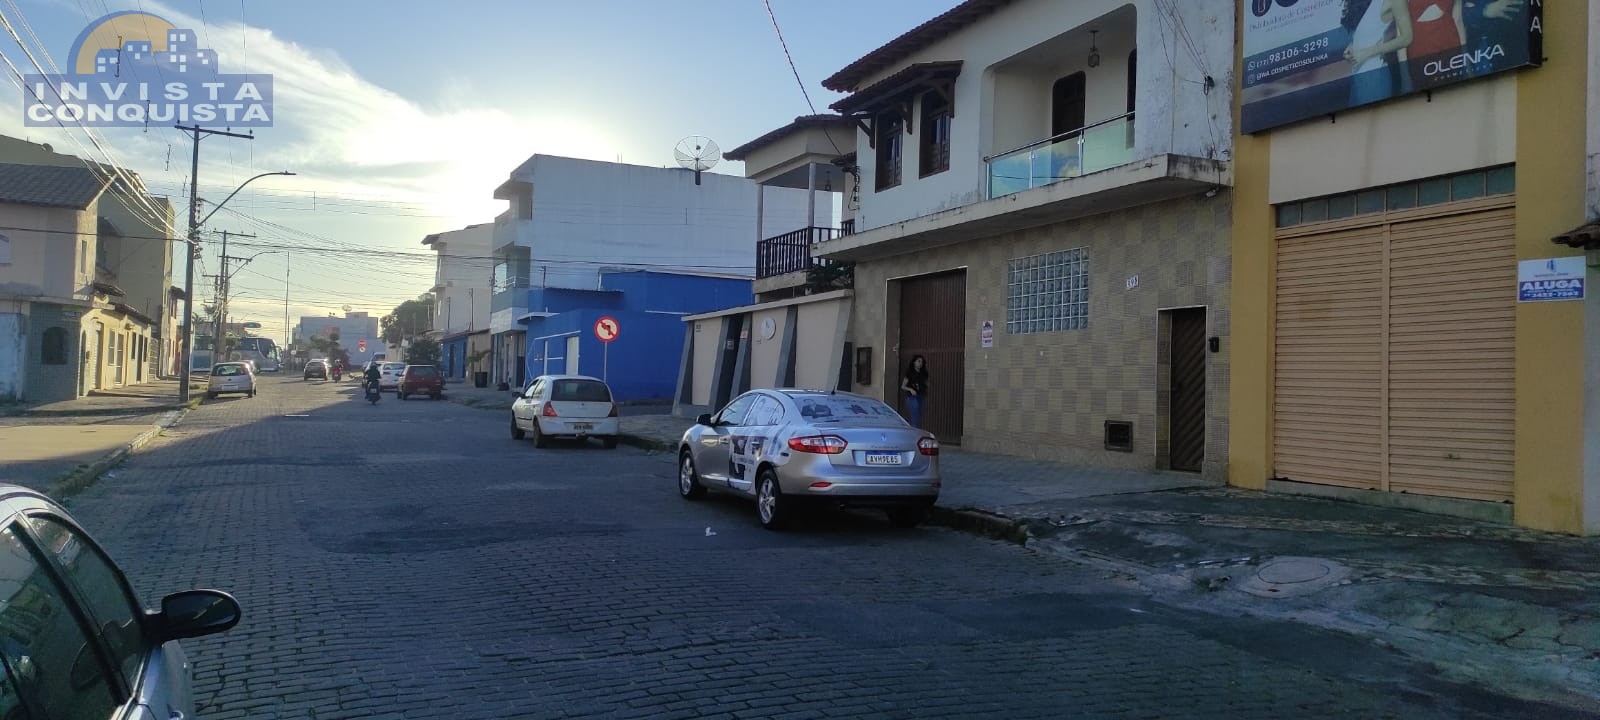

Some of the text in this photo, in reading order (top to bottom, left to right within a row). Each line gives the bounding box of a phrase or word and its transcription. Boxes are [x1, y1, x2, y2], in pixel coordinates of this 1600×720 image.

[1269, 37, 1329, 63] 98106-3298
[1424, 44, 1505, 76] OLENKA
[1522, 279, 1582, 291] ALUGA
